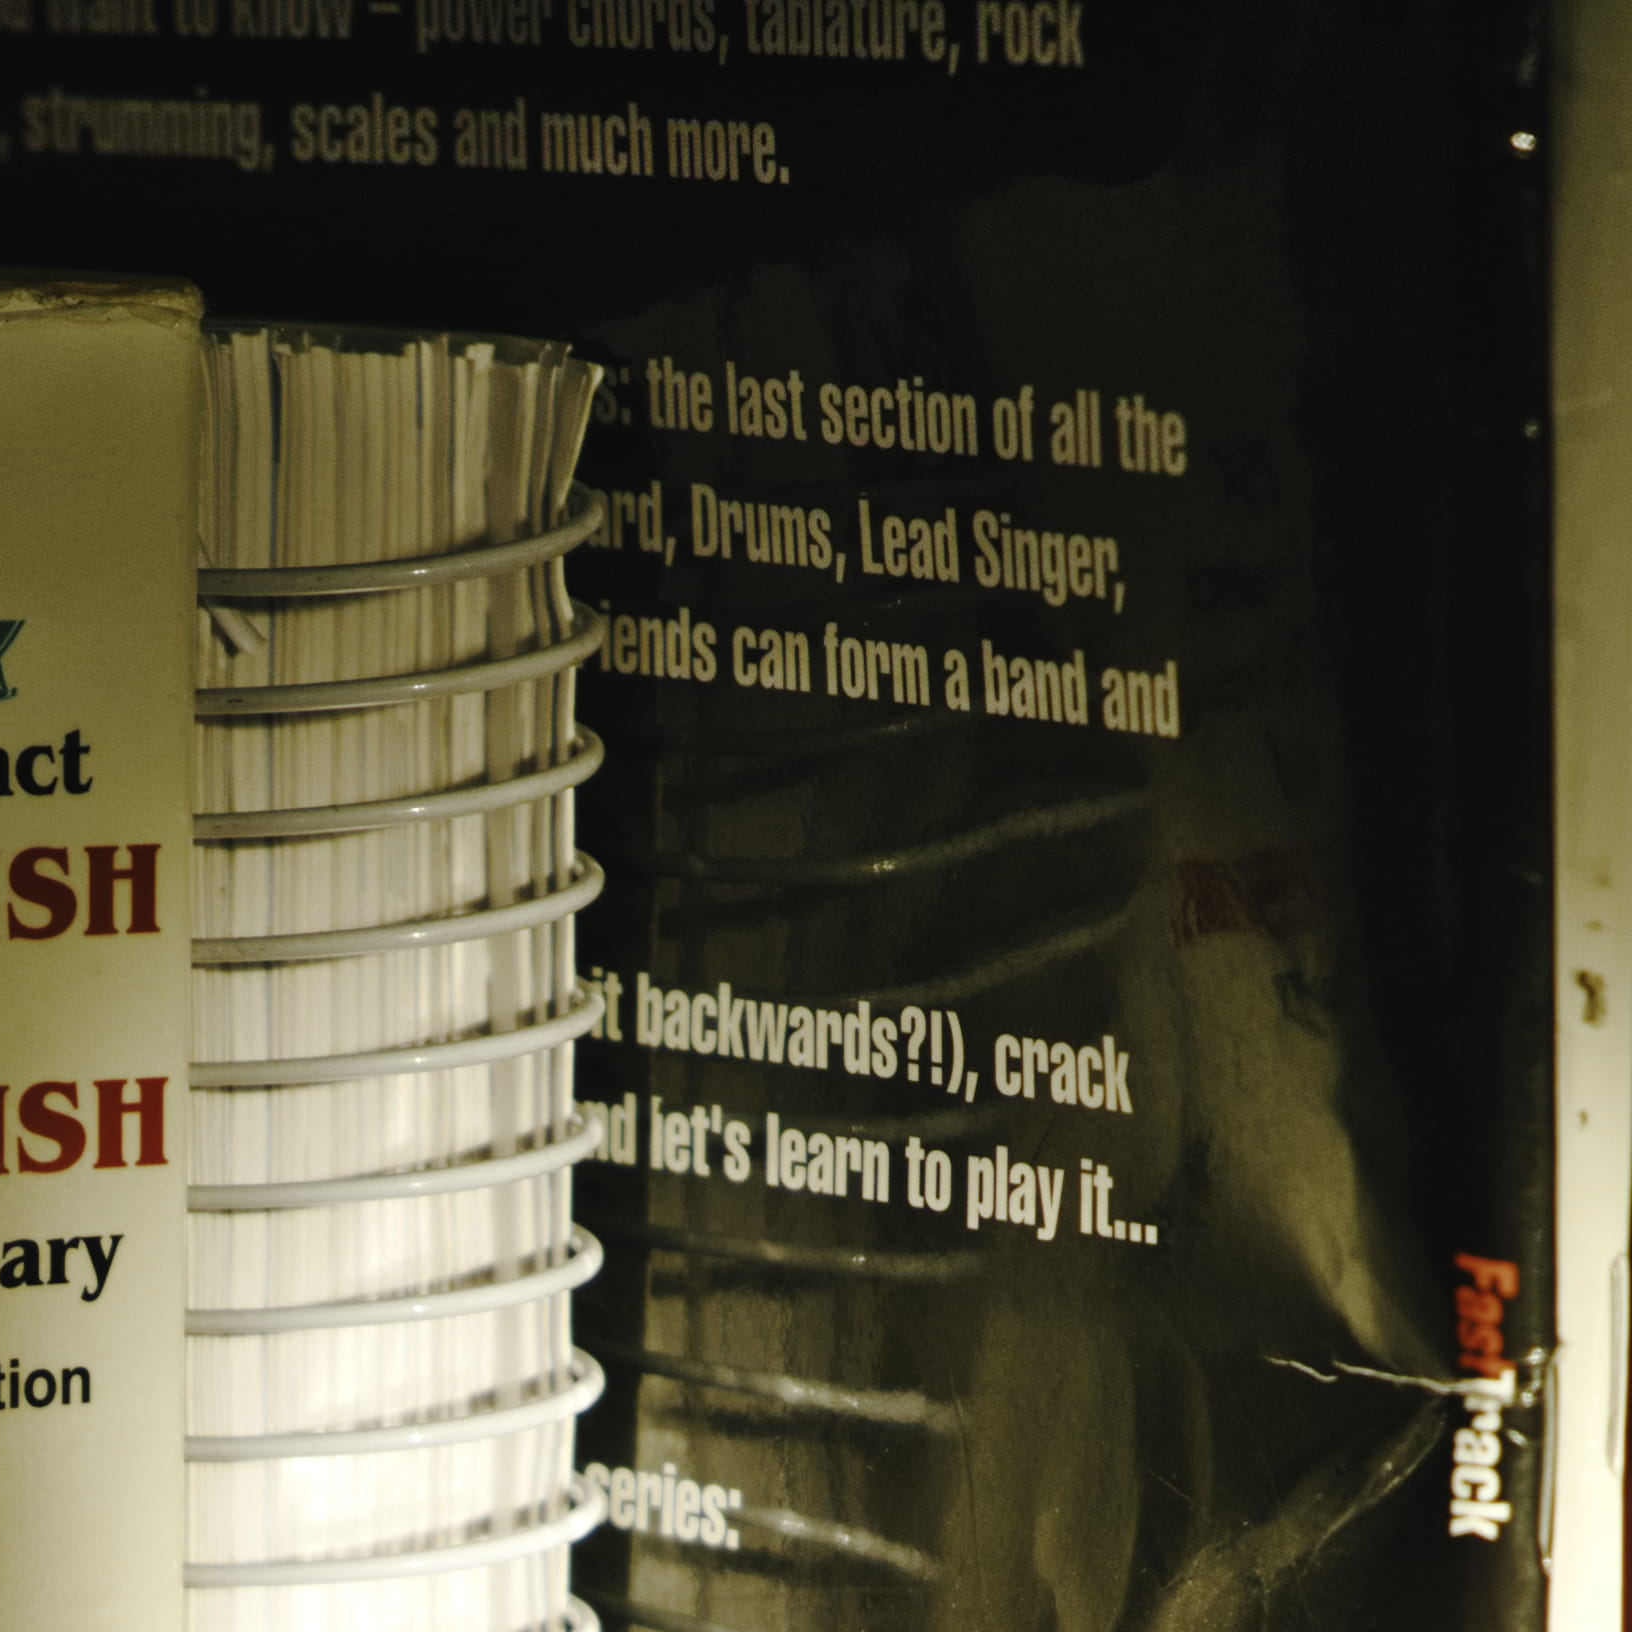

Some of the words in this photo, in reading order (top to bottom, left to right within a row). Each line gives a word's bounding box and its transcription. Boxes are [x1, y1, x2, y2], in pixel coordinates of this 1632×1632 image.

[568, 0, 729, 66] chords,
[746, 0, 960, 76] tablature,
[977, 0, 1085, 68] rock
[290, 91, 438, 166] scales
[454, 97, 527, 171] and
[541, 102, 654, 178] much
[667, 116, 791, 185] more.
[649, 356, 714, 434] the
[726, 361, 807, 441] last
[820, 376, 978, 457] section
[993, 384, 1035, 462] of
[1050, 389, 1102, 468] all
[1116, 395, 1187, 477] the
[690, 482, 847, 584] Drums,
[857, 497, 961, 584] Lead
[972, 509, 1125, 616] Singer,
[733, 623, 811, 693] can
[823, 621, 930, 706] form
[944, 648, 970, 712] a
[980, 639, 1089, 726] band
[1101, 660, 1180, 739] and
[637, 971, 978, 1103] backwards?!),
[994, 1034, 1133, 1114] crack
[650, 1095, 752, 1184] let's
[766, 1112, 889, 1202] learn
[904, 1135, 951, 1213] to
[967, 1146, 1065, 1241] play
[1079, 1158, 1159, 1245] it...
